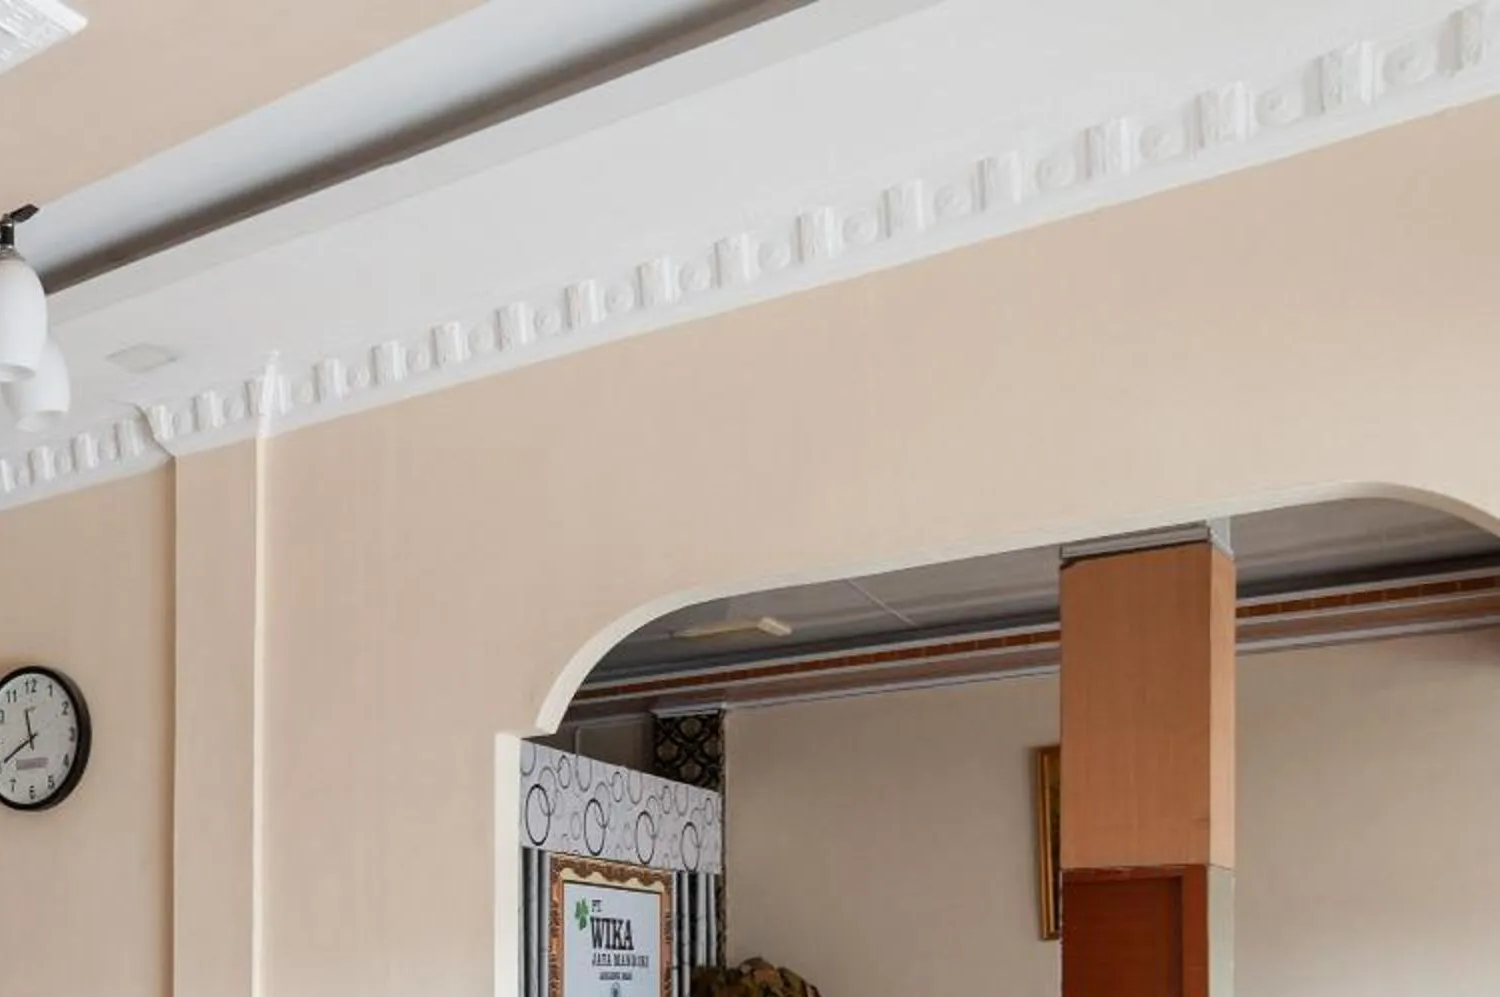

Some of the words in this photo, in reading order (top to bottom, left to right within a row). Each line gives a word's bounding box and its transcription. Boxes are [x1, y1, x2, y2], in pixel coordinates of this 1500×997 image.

[25, 679, 37, 694] 12
[48, 685, 53, 696] 1
[6, 690, 17, 703] 11
[61, 701, 69, 715] 2
[69, 726, 75, 742] 3
[64, 754, 69, 768] 4
[10, 779, 16, 793] 7
[48, 776, 55, 790] 5
[29, 786, 36, 800] 6
[590, 917, 634, 951] WIKA
